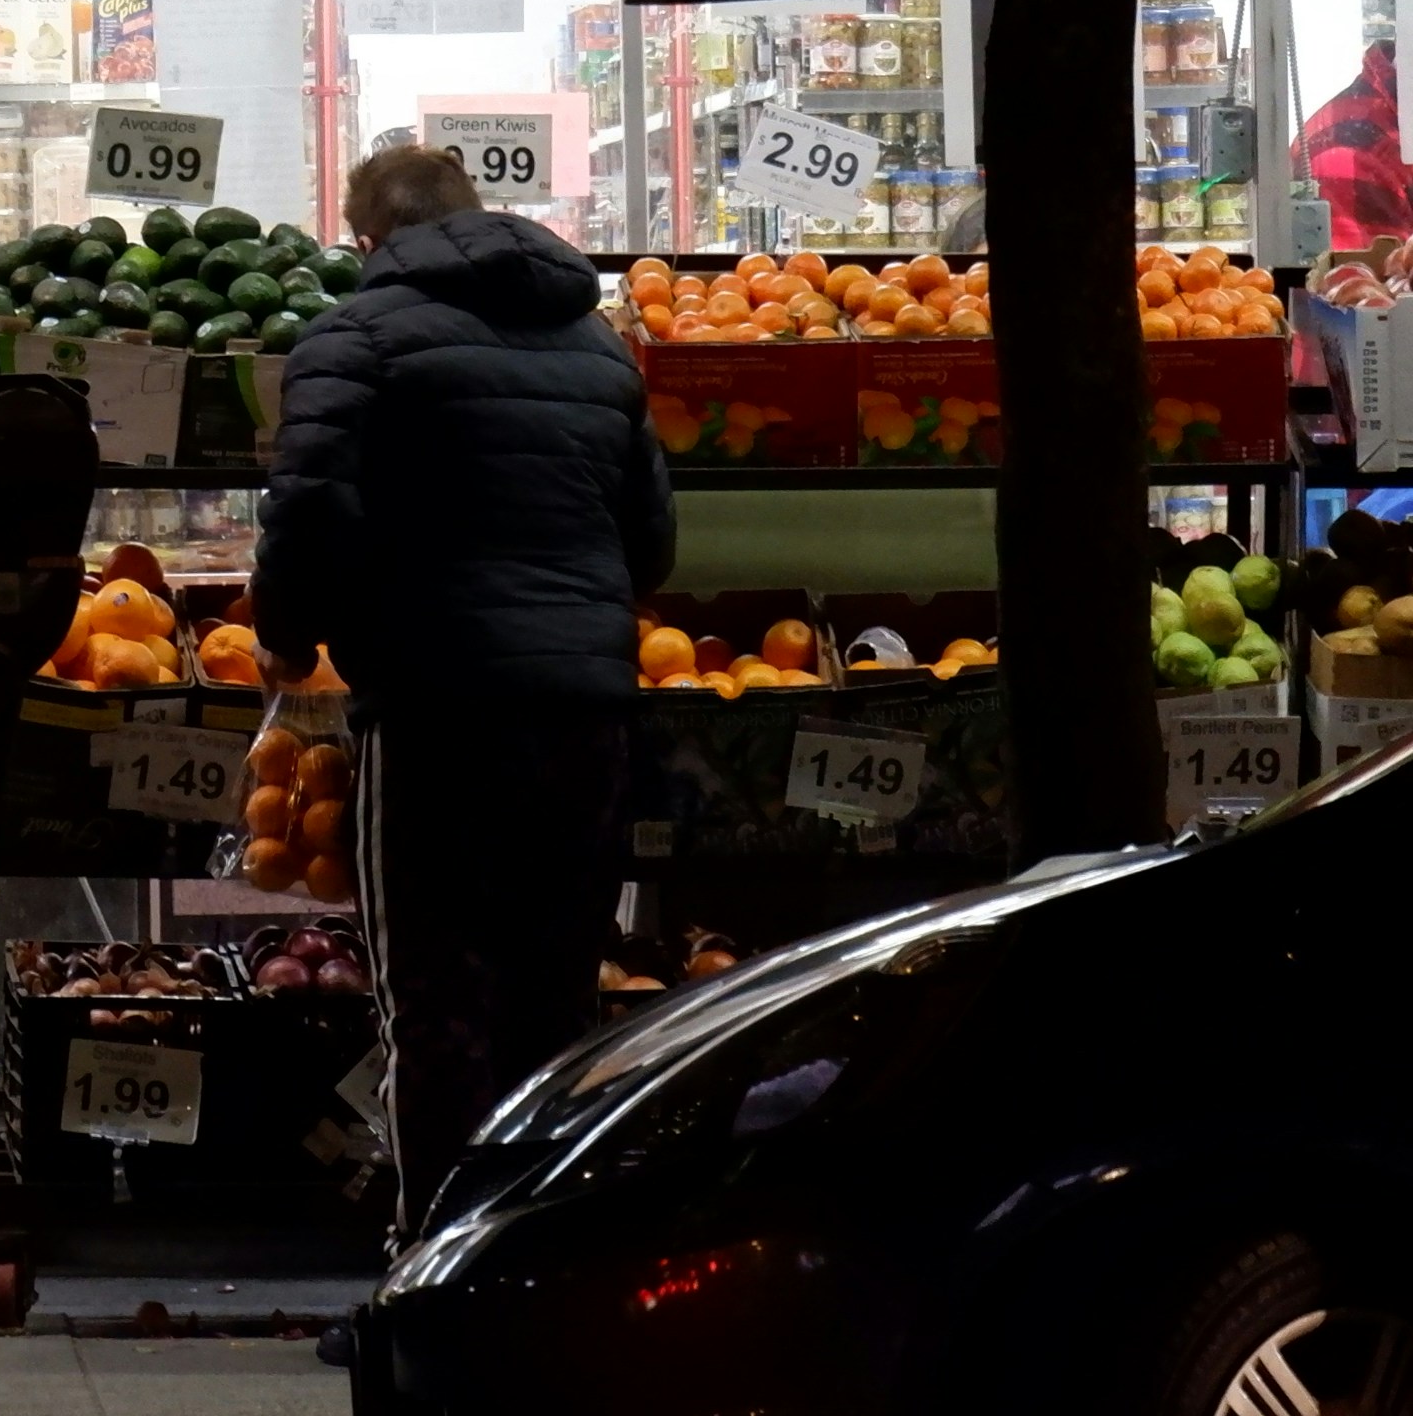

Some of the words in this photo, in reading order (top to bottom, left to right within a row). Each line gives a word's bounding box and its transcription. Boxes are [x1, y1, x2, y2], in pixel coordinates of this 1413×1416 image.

[119, 1, 149, 22] plus
[119, 115, 197, 134] Avocados
[441, 116, 491, 132] Green
[496, 116, 537, 133] Kiwis
[107, 142, 201, 182] 0.99
[763, 132, 860, 186] 2.99
[1180, 720, 1237, 736] Bartlett
[1244, 720, 1289, 736] Pears
[131, 754, 226, 799] 1.49
[810, 749, 904, 795] 1.49
[1187, 747, 1280, 785] 1.49
[92, 1044, 158, 1065] Shallots
[75, 1072, 170, 1120] 1.99
